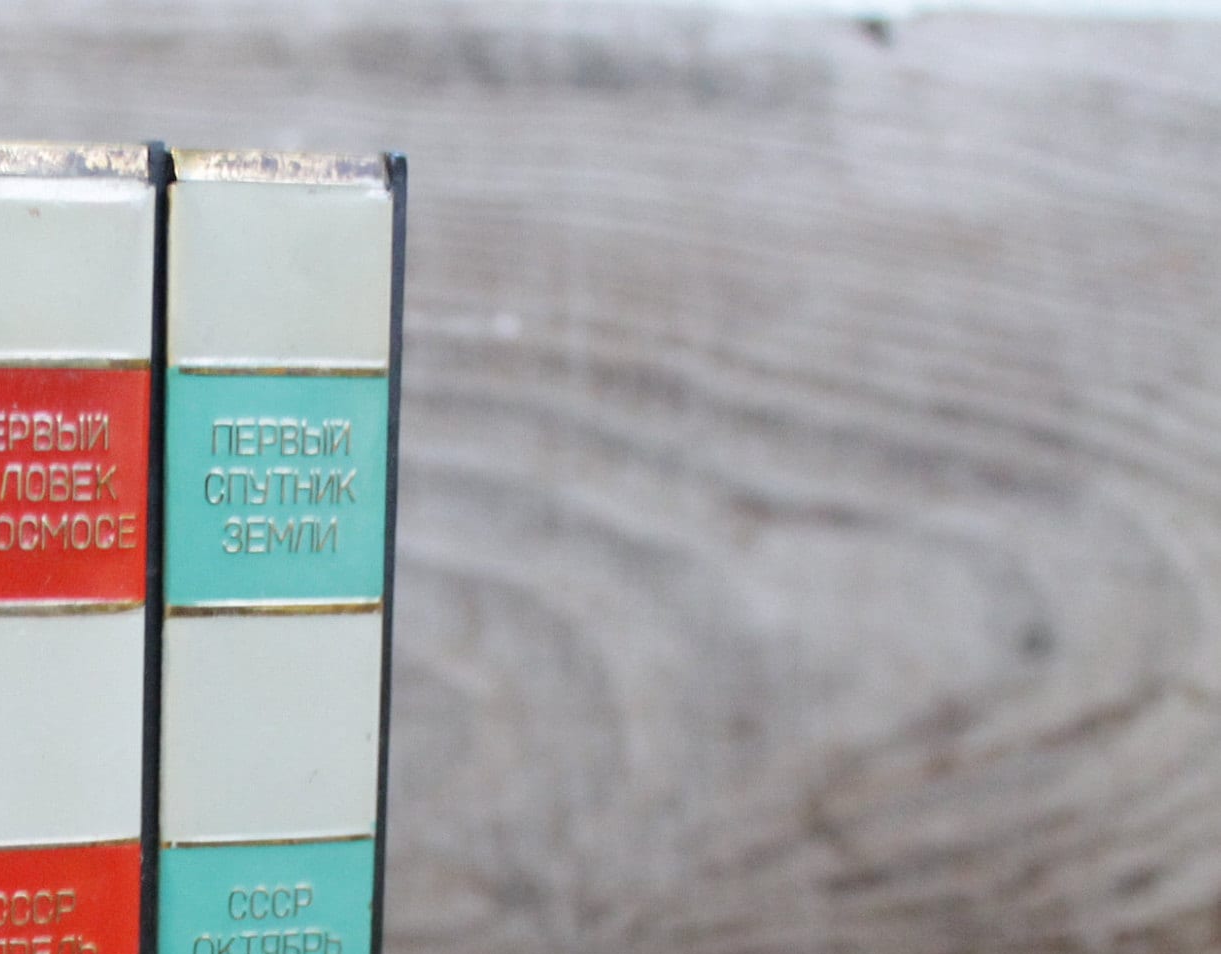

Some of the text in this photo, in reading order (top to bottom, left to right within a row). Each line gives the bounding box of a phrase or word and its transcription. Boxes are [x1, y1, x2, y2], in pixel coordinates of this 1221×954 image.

[211, 416, 352, 456] ПЕРВЫЙ
[204, 466, 357, 505] СПУТНИК
[222, 515, 338, 554] ЗЕМЛИ
[228, 881, 313, 921] СССР
